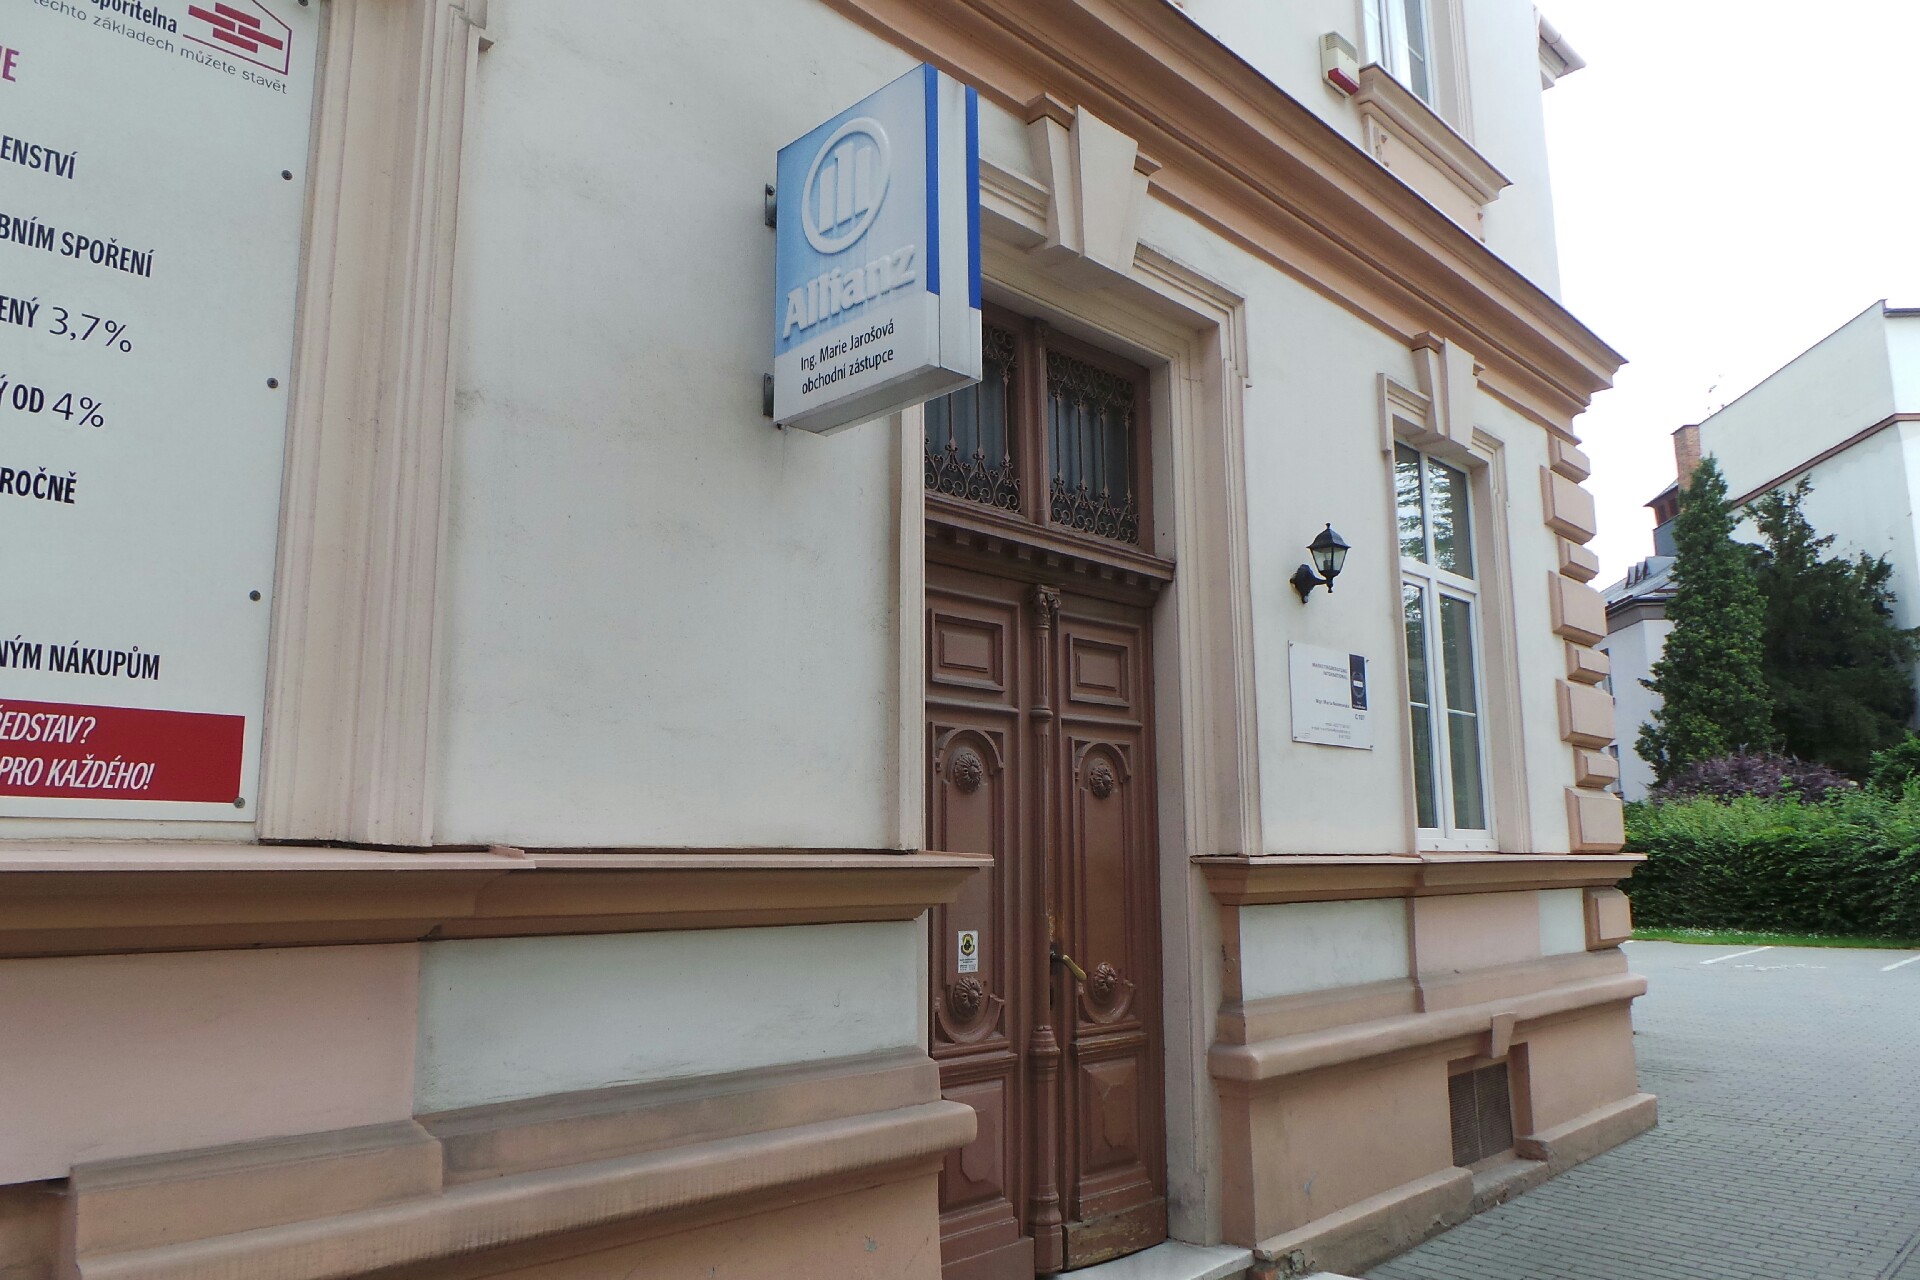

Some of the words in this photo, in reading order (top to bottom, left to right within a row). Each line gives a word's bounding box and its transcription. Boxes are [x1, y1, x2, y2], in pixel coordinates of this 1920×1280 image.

[93, 15, 174, 53] základech
[180, 47, 237, 75] můžete
[241, 70, 287, 94] stavět
[0, 134, 78, 180] ENSTVÍ
[0, 212, 55, 252] BNÍM
[60, 230, 155, 278] SPOŘENÍ
[782, 244, 916, 341] Allianz
[0, 294, 40, 328] ENÝ
[49, 306, 132, 353] 3,7%
[800, 355, 818, 371] Ing.
[819, 339, 848, 363] Marie
[849, 318, 895, 351] Jarošová
[801, 363, 847, 394] obchodní
[848, 348, 895, 376] zástupce
[12, 383, 45, 414] OD
[52, 392, 105, 428] 4%
[0, 465, 77, 504] ROČNĚ
[48, 640, 161, 681] NÁKUPŮM
[0, 704, 97, 744] EDSTAV?
[0, 755, 44, 787] PRO
[45, 753, 156, 790] KAŽDÉHO!
